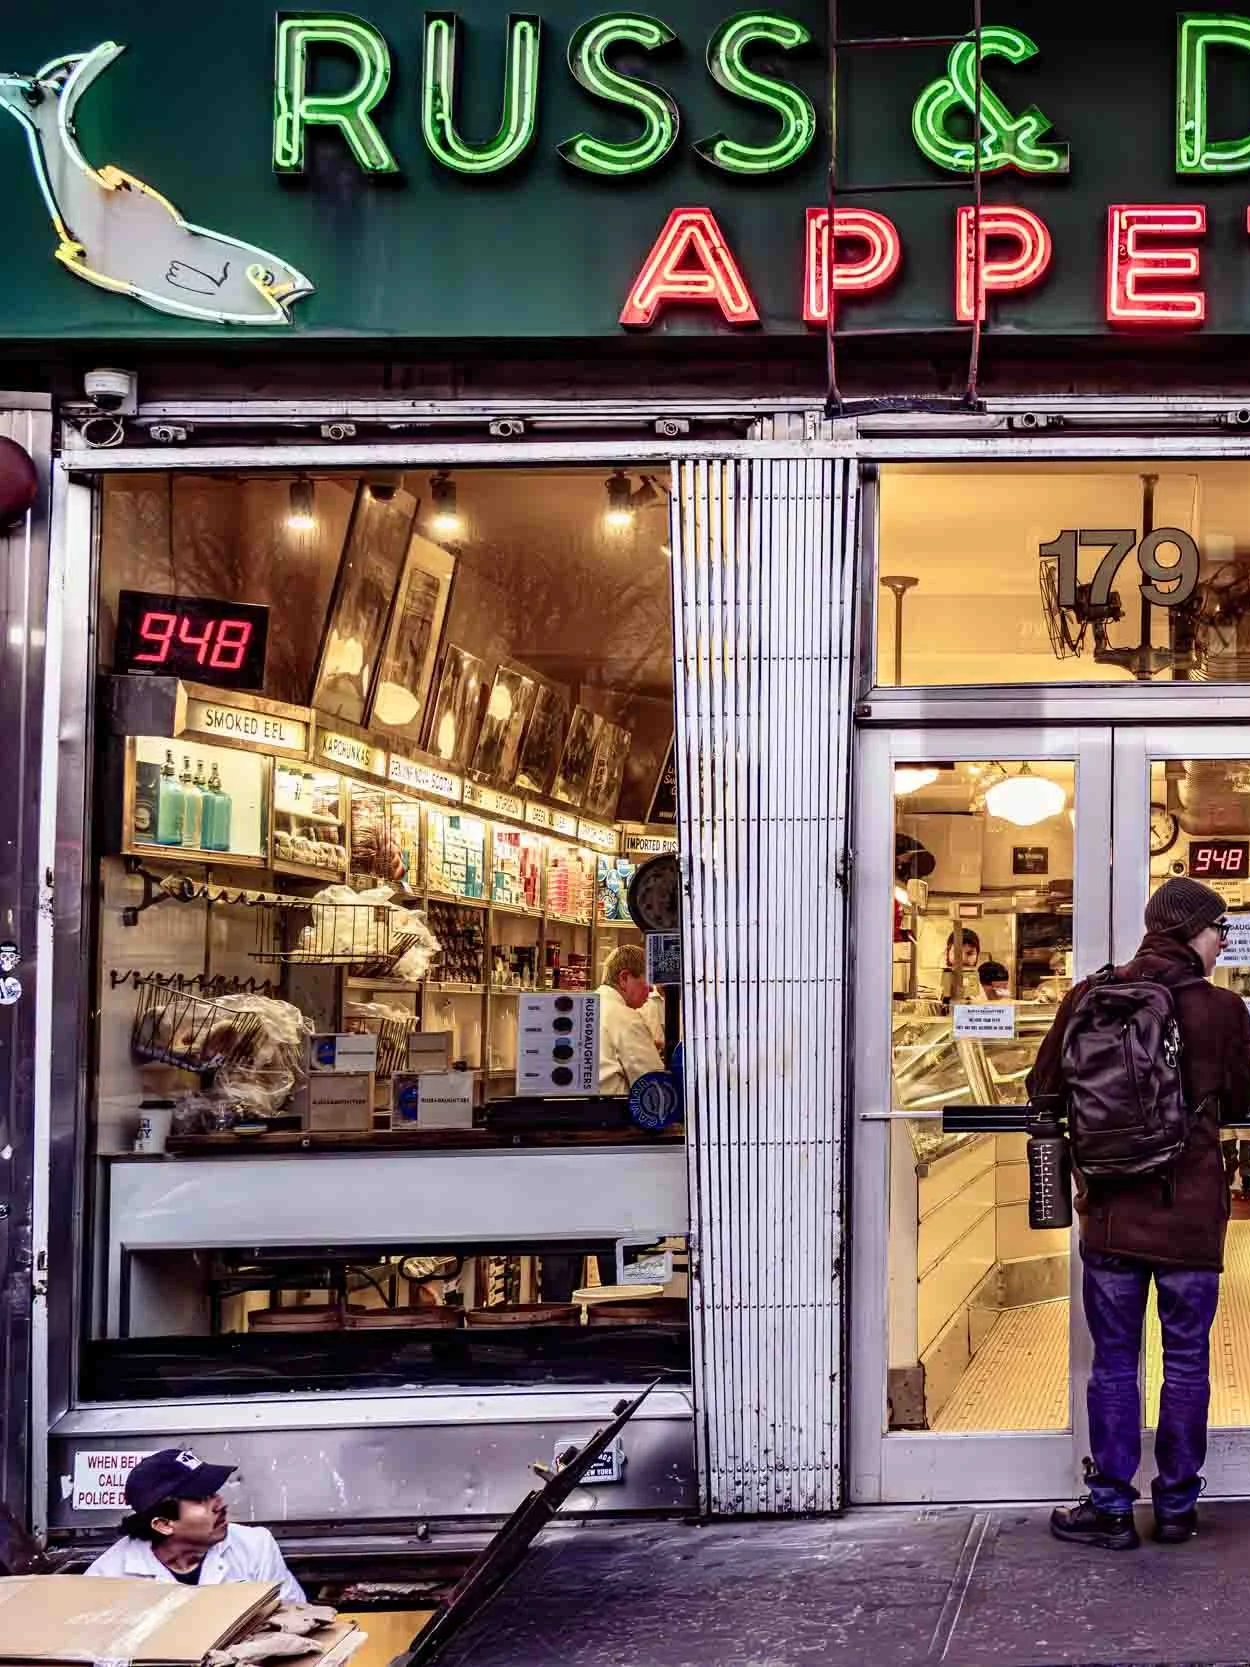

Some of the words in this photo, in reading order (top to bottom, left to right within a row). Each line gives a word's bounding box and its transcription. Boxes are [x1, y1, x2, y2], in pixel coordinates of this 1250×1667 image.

[274, 10, 816, 175] RUSS
[912, 25, 1070, 175] &
[1039, 526, 1201, 607] 179
[132, 611, 254, 670] 948
[205, 709, 259, 736] SMOKED
[263, 720, 287, 742] EEL
[627, 837, 661, 851] IMPORTED
[662, 840, 678, 851] RUS
[1195, 848, 1243, 871] 948
[87, 1455, 119, 1469] WHEN
[98, 1473, 125, 1487] CALL
[78, 1491, 115, 1505] POLICE
